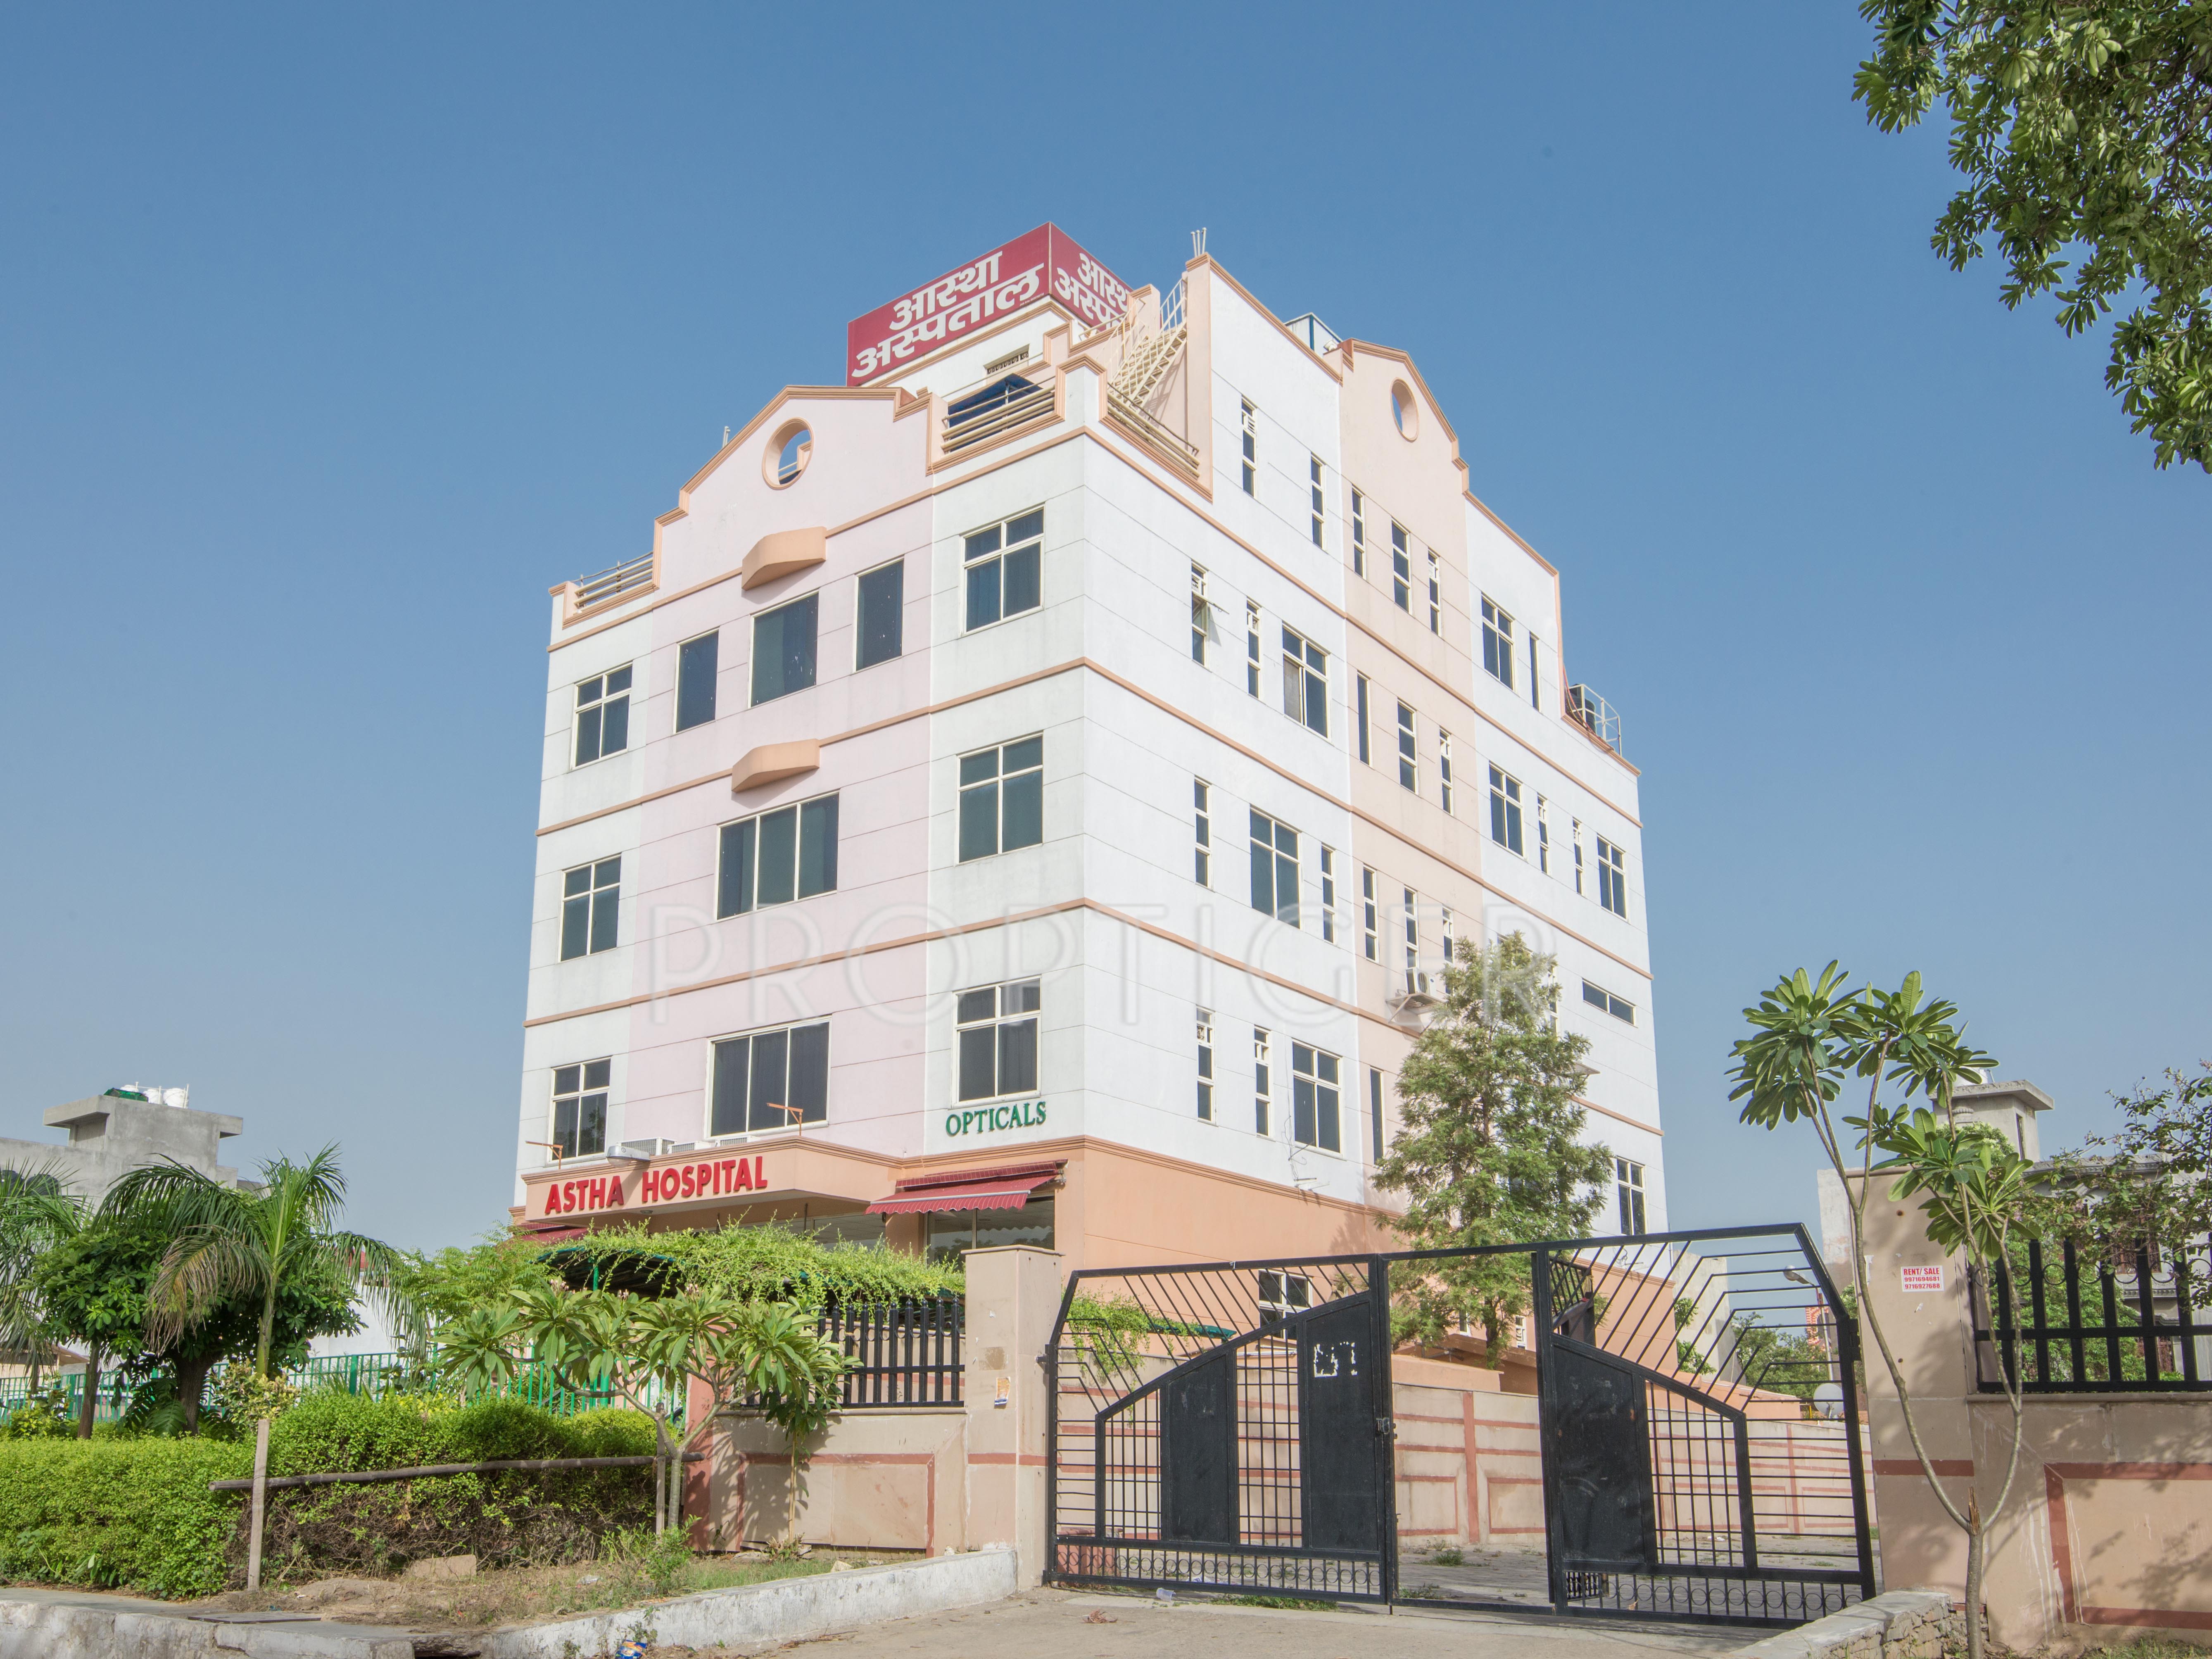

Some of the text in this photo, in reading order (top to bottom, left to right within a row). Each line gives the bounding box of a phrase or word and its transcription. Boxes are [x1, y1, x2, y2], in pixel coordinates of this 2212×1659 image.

[851, 263, 1044, 378] अस्पताल
[889, 251, 1003, 330] आस्था
[946, 1101, 1046, 1136] OPTICALS
[544, 1156, 768, 1214] ASTHA HOSPITAL
